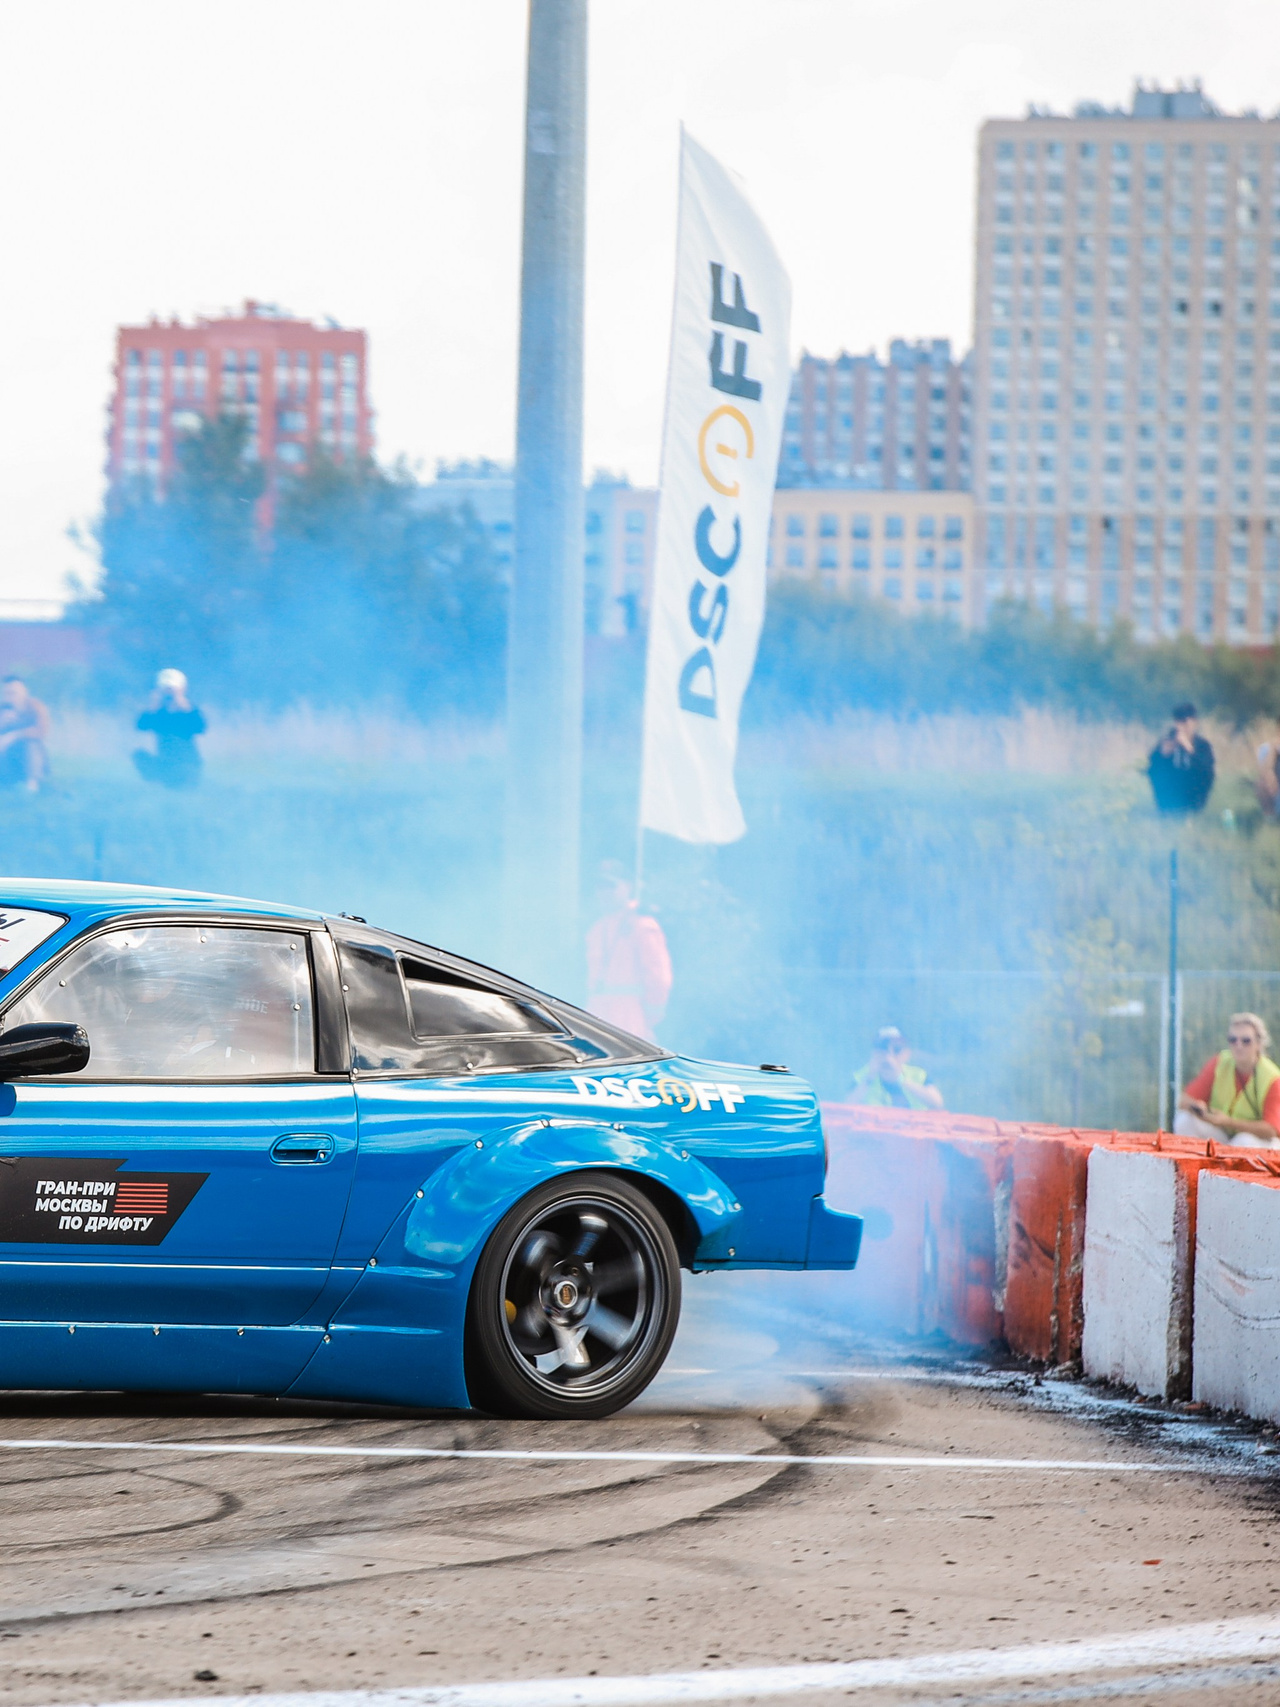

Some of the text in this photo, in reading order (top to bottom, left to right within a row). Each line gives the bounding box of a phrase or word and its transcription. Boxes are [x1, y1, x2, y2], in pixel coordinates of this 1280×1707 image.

[35, 1180, 117, 1196] ГРАН-ПРИ
[34, 1197, 108, 1213] МОСКВЫ
[58, 1215, 154, 1232] ПО ДРИФТУ
